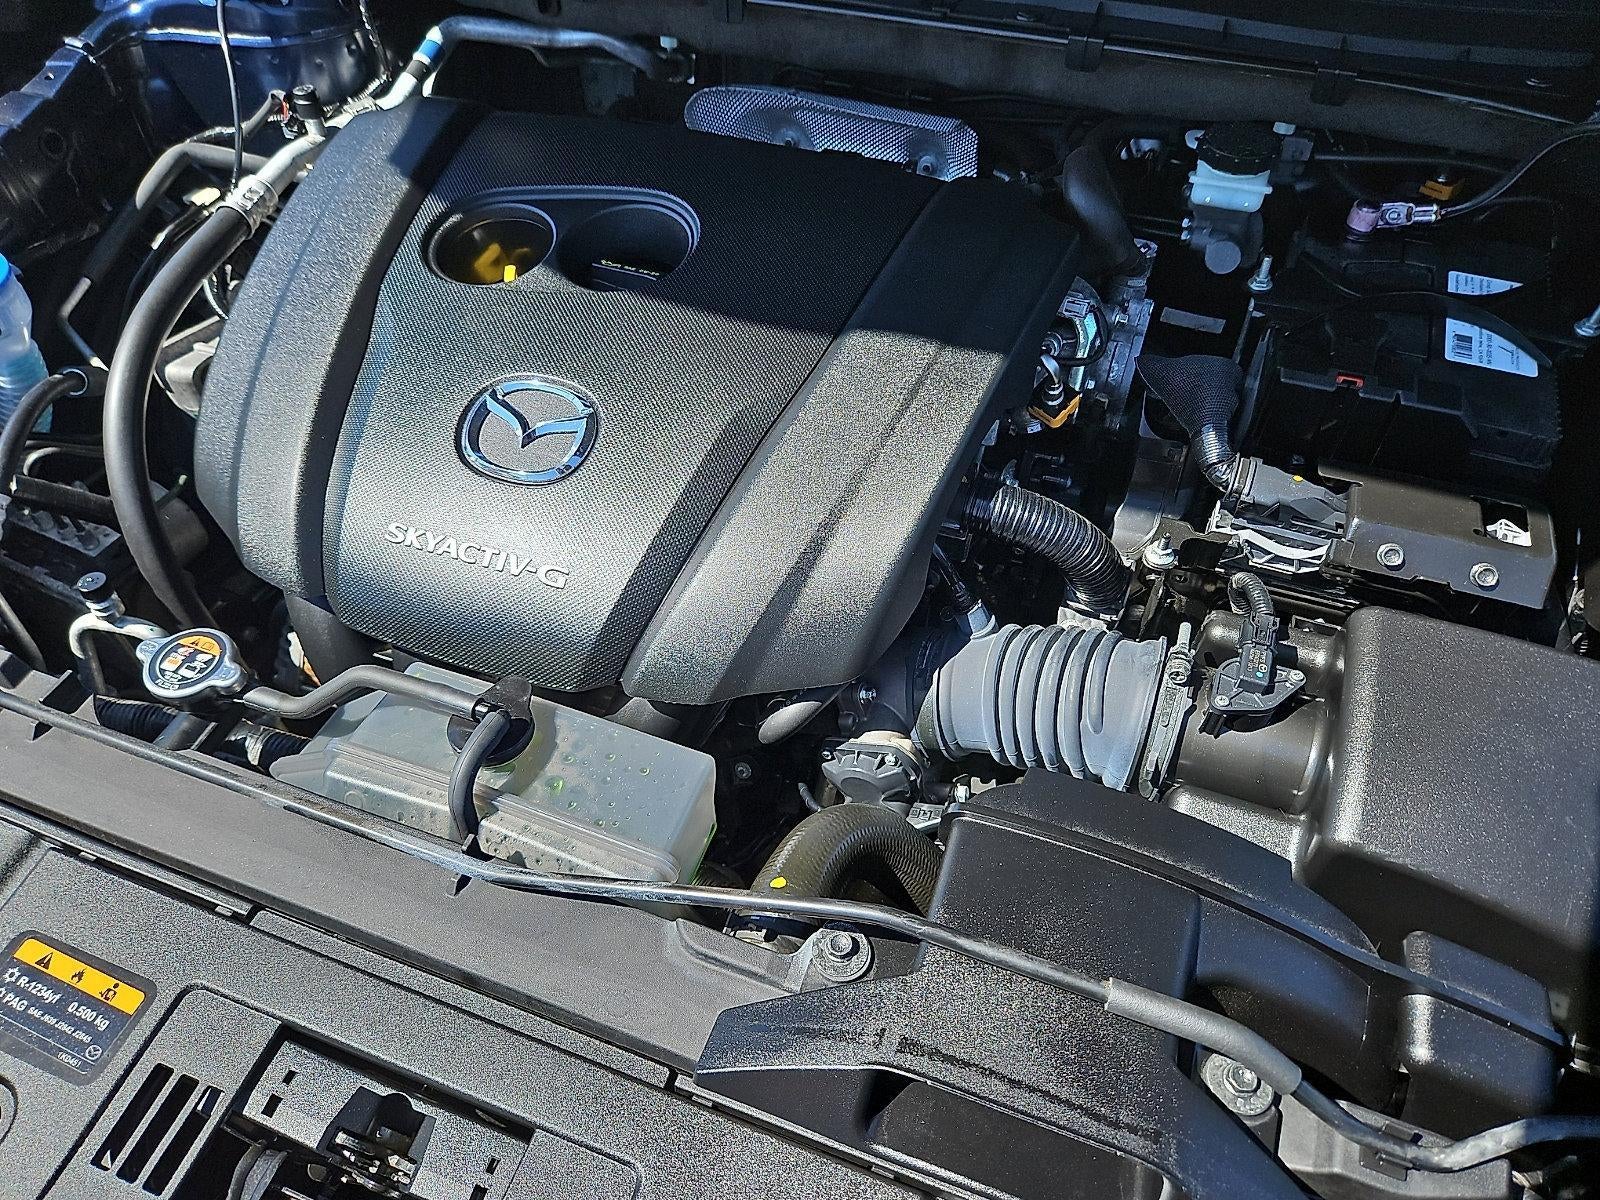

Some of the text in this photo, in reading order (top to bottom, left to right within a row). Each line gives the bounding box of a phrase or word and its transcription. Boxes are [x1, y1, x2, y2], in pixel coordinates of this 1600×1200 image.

[385, 522, 569, 590] SKYACTIV-G
[3, 993, 28, 1012] PAG
[28, 1006, 44, 1019] SAE
[16, 975, 110, 1032] R-1234yf 0.500 kg
